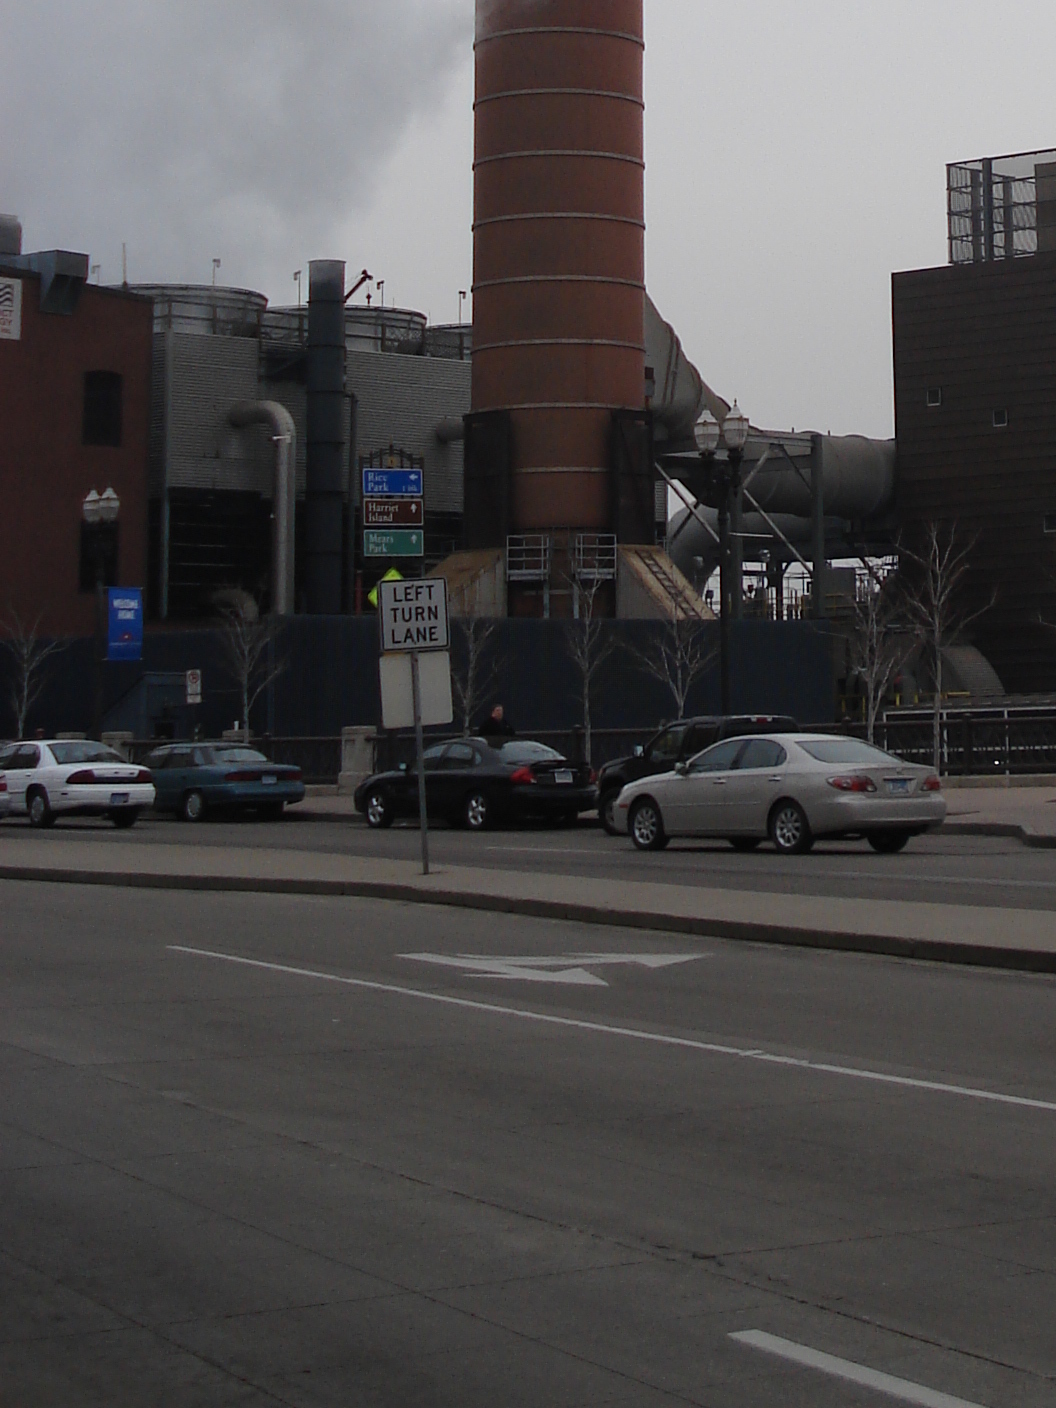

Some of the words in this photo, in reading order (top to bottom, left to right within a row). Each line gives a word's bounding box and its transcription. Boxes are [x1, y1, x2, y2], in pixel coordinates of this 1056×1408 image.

[368, 472, 388, 481] Rice
[368, 482, 389, 491] Park
[368, 502, 399, 512] Harriet
[368, 513, 393, 522] Island
[369, 533, 394, 543] Mears
[369, 543, 388, 553] Park
[393, 585, 434, 602] LEFT
[390, 605, 438, 623] TURN
[391, 626, 439, 644] LANE
